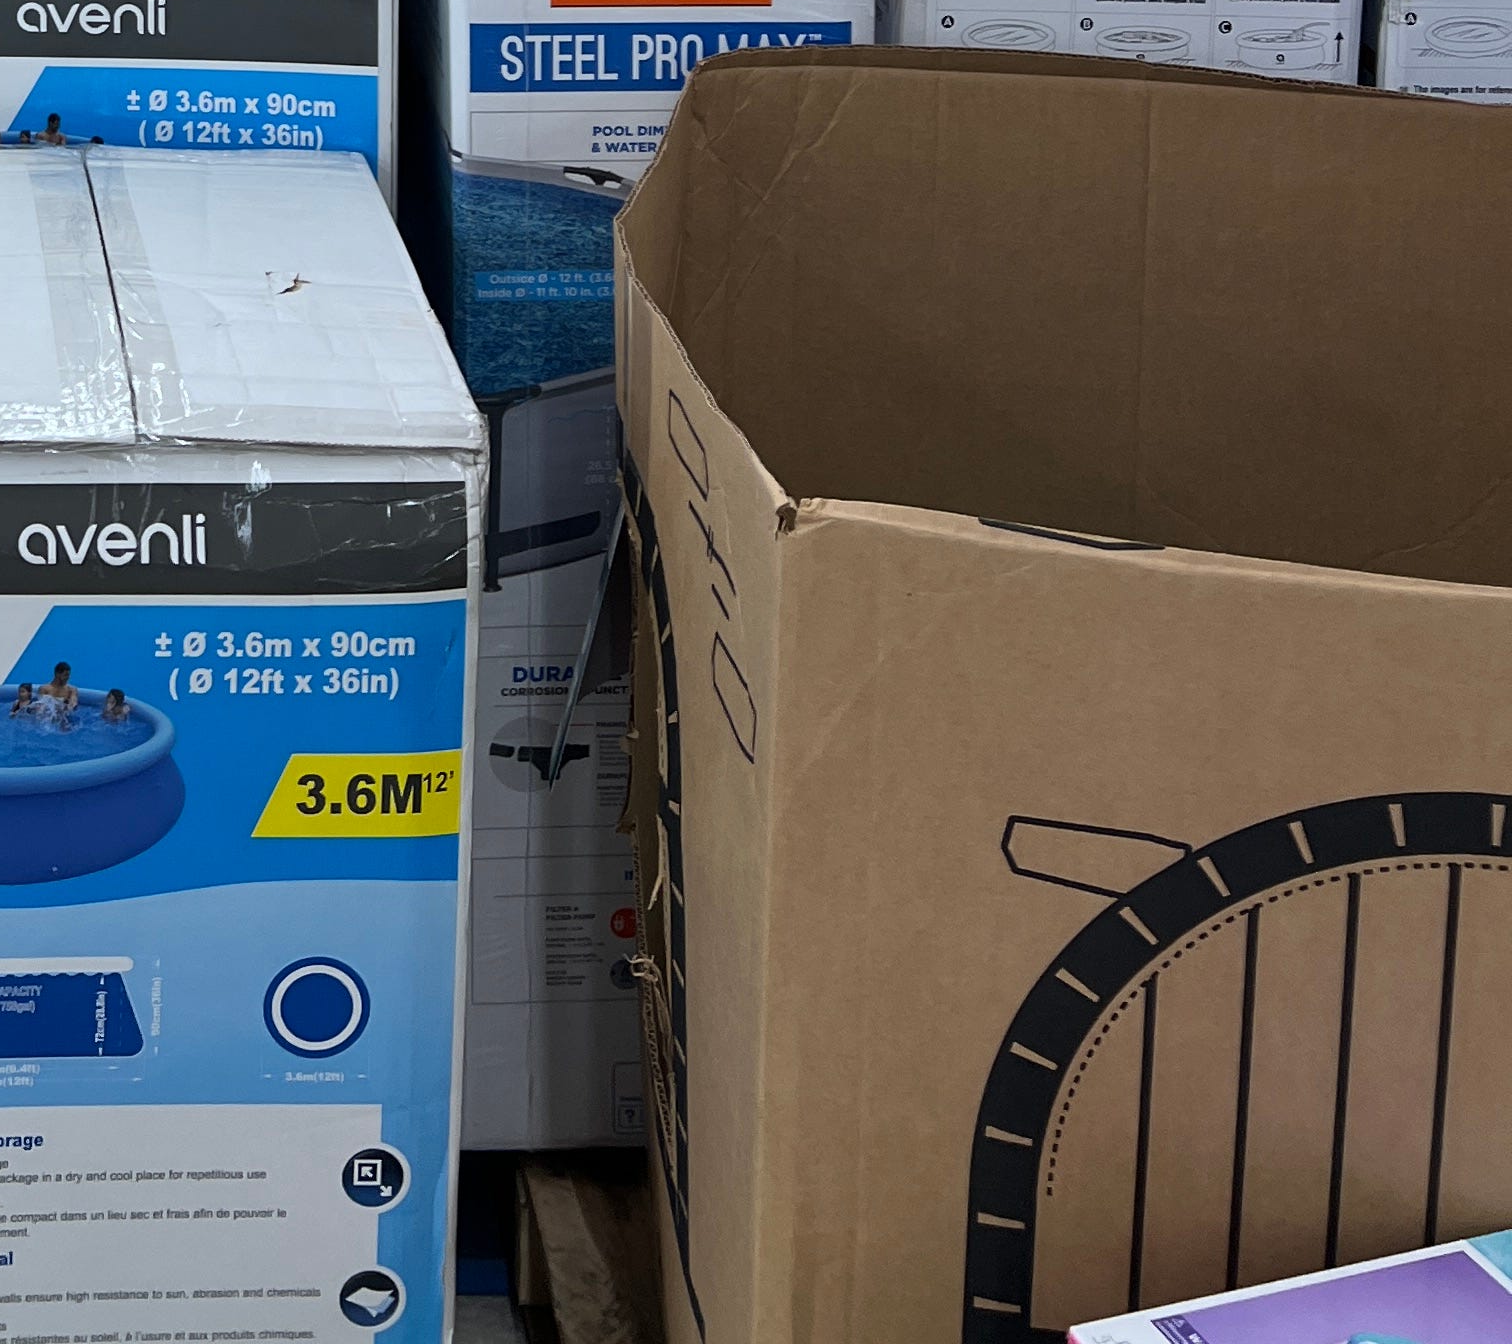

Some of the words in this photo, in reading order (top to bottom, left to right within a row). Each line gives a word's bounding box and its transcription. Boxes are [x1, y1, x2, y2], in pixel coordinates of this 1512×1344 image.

[500, 34, 619, 82] STEEL
[631, 34, 704, 80] PRO
[149, 89, 168, 112] Ø
[176, 90, 236, 113] 3.6m
[244, 97, 259, 114] x
[267, 93, 336, 117] 90cm
[155, 120, 174, 142] Ø
[182, 121, 231, 144] 12ft
[238, 128, 254, 145] x
[261, 123, 323, 150] 36in)
[592, 125, 634, 137] POOL
[638, 125, 669, 137] DIM
[591, 142, 601, 153] &
[606, 141, 657, 153] WATER
[490, 274, 535, 284] Outside
[559, 274, 571, 283] 12
[590, 273, 614, 284] (3.6
[478, 289, 512, 298] Inside
[564, 287, 577, 296] 10
[17, 513, 207, 565] avenli
[183, 631, 207, 657] Ø
[216, 631, 292, 658] 3.6m
[302, 637, 321, 657] x
[331, 631, 415, 657] 90cm
[512, 666, 575, 682] DURA
[189, 668, 213, 694] Ø
[223, 668, 285, 694] 12ft
[294, 674, 313, 694] x
[323, 667, 400, 700] 36in)
[295, 773, 423, 815] 3.6M
[42, 1173, 52, 1181] in
[66, 1172, 82, 1184] dry
[86, 1171, 106, 1181] and
[110, 1170, 133, 1181] cool
[136, 1169, 166, 1183] place
[169, 1169, 183, 1180] for
[247, 1170, 267, 1180] use
[10, 1212, 57, 1225] compact
[60, 1211, 87, 1221] dans
[91, 1212, 104, 1220] un
[108, 1210, 127, 1220] lieu
[130, 1211, 150, 1220] sec
[153, 1210, 163, 1219] et
[167, 1209, 190, 1219] frais
[193, 1209, 213, 1219] afin
[216, 1209, 230, 1219] de
[233, 1208, 273, 1221] pouvoir
[277, 1208, 287, 1218] le
[25, 1293, 63, 1302] ensure
[66, 1292, 90, 1304] high
[93, 1289, 149, 1301] resistance
[152, 1289, 163, 1299] to
[193, 1288, 239, 1299] abrasion
[243, 1288, 263, 1298] and
[267, 1287, 322, 1298] chemicals
